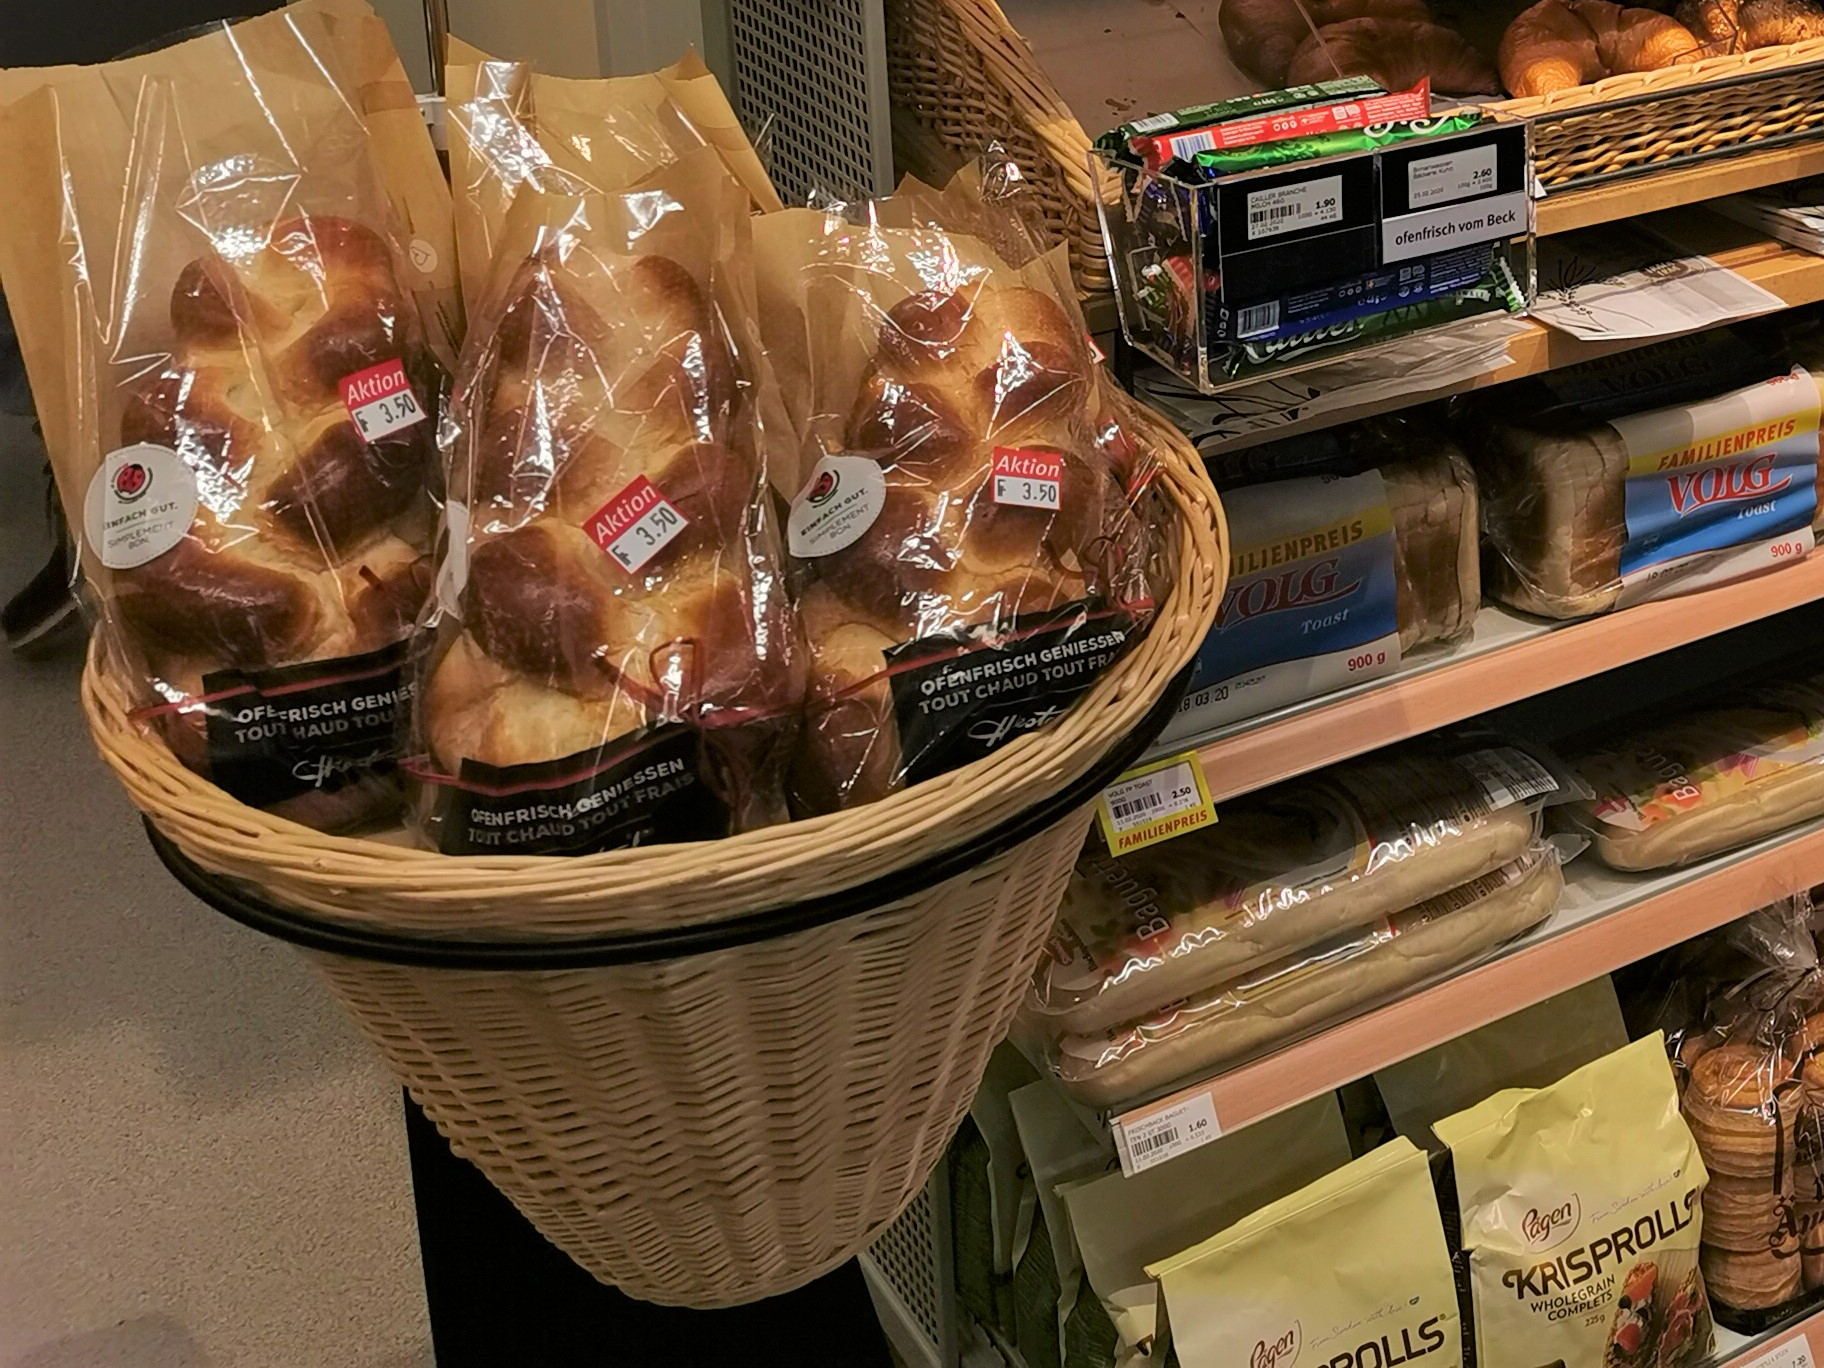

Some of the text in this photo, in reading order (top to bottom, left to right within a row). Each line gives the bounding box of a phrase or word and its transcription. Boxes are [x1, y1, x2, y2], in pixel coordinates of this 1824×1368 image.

[1473, 168, 1492, 179] 2.60
[1315, 198, 1336, 209] 1.90
[1395, 210, 1516, 246] ofenfrisch vom Beck
[346, 369, 407, 406] Aktion
[378, 395, 417, 424] 3.50
[1656, 418, 1796, 472] FAMILIENPREIS
[996, 454, 1060, 478] Aktion
[1022, 485, 1057, 503] 3.50
[1667, 452, 1793, 519] VOLG
[595, 485, 657, 544] Aktion
[645, 504, 678, 546] 3.50
[1230, 521, 1363, 577] ILIENPREIS
[1771, 542, 1802, 557] 900 g
[1215, 558, 1362, 633] VOLG
[1301, 608, 1350, 635] Toast
[920, 630, 1126, 696] OFENFRISCH GENIESSEN
[1348, 651, 1386, 672] 900 g
[918, 652, 1116, 715] TOUT CHAUD TOUT FRA
[294, 717, 349, 741] HAUD
[468, 771, 697, 847] TOUT CHAUD TOUT FRAIS
[470, 757, 686, 827] OFENFRISCH GENIESSEN
[1172, 787, 1191, 799] 2.50
[1118, 810, 1208, 850] FAMILIENPREIS
[1188, 1118, 1208, 1133] 1.60
[1522, 1200, 1572, 1243] Pågen
[1502, 1185, 1702, 1301] KRISPROLLS
[1530, 1274, 1617, 1313] WHOLEGRAIN
[1547, 1290, 1613, 1322] COMPLETS
